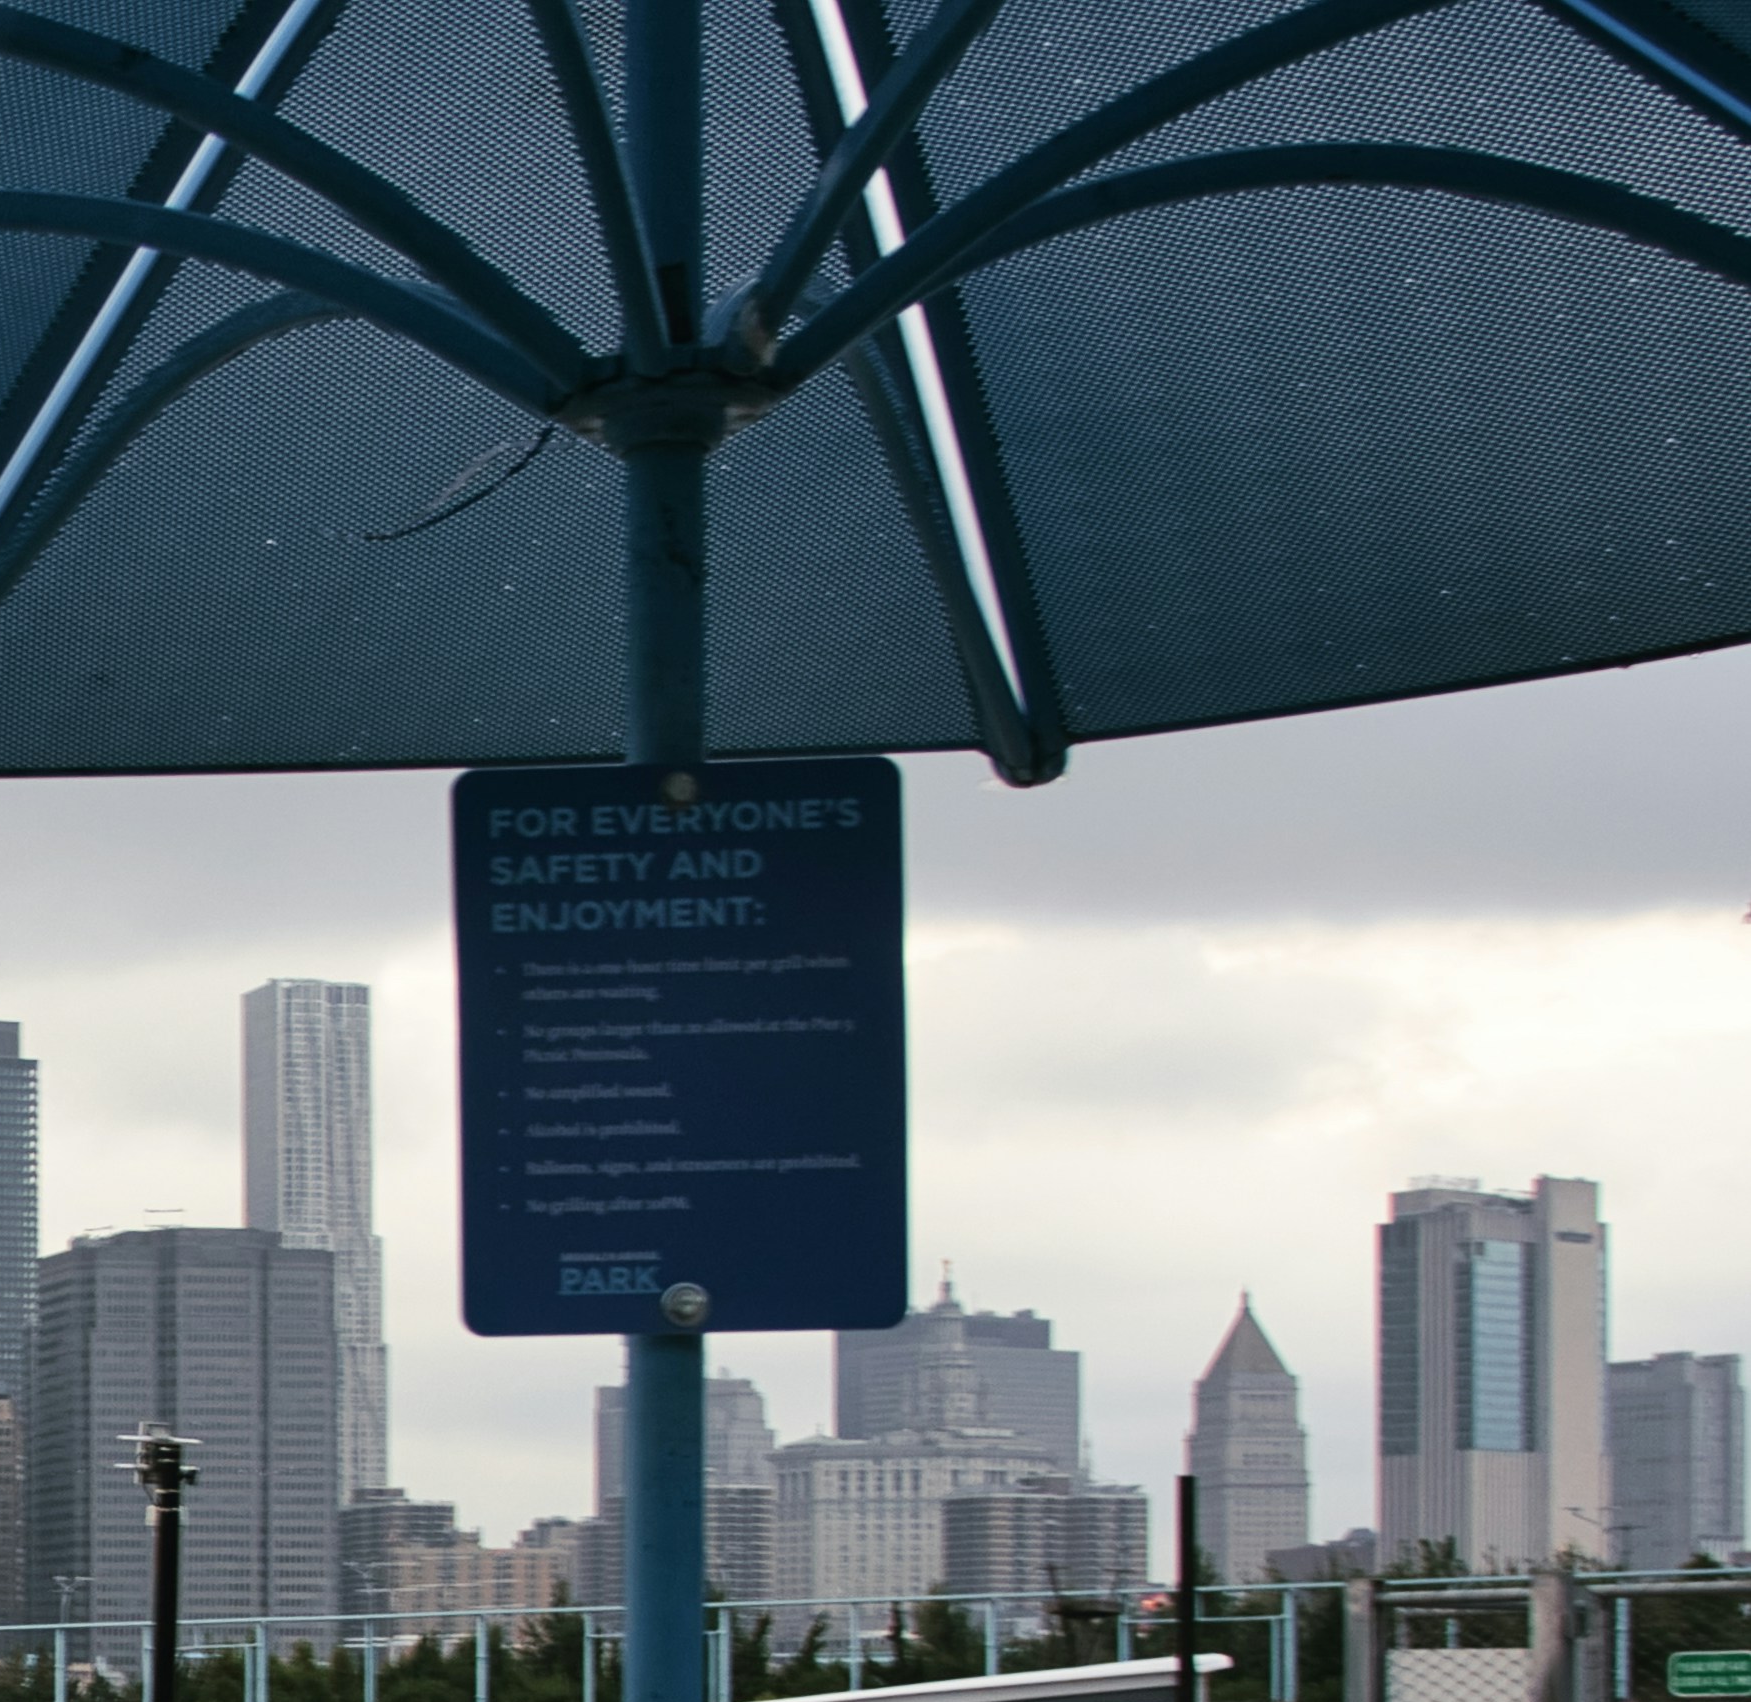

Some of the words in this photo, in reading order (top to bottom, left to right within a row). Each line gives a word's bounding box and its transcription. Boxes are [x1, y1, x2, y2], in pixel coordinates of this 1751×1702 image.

[489, 807, 577, 838] FOR
[591, 798, 861, 836] EVERYONE'S
[489, 852, 654, 886] SAFETY
[668, 849, 763, 880] AND
[491, 896, 766, 933] ENJOYMENT:
[560, 1266, 659, 1291] PARK
